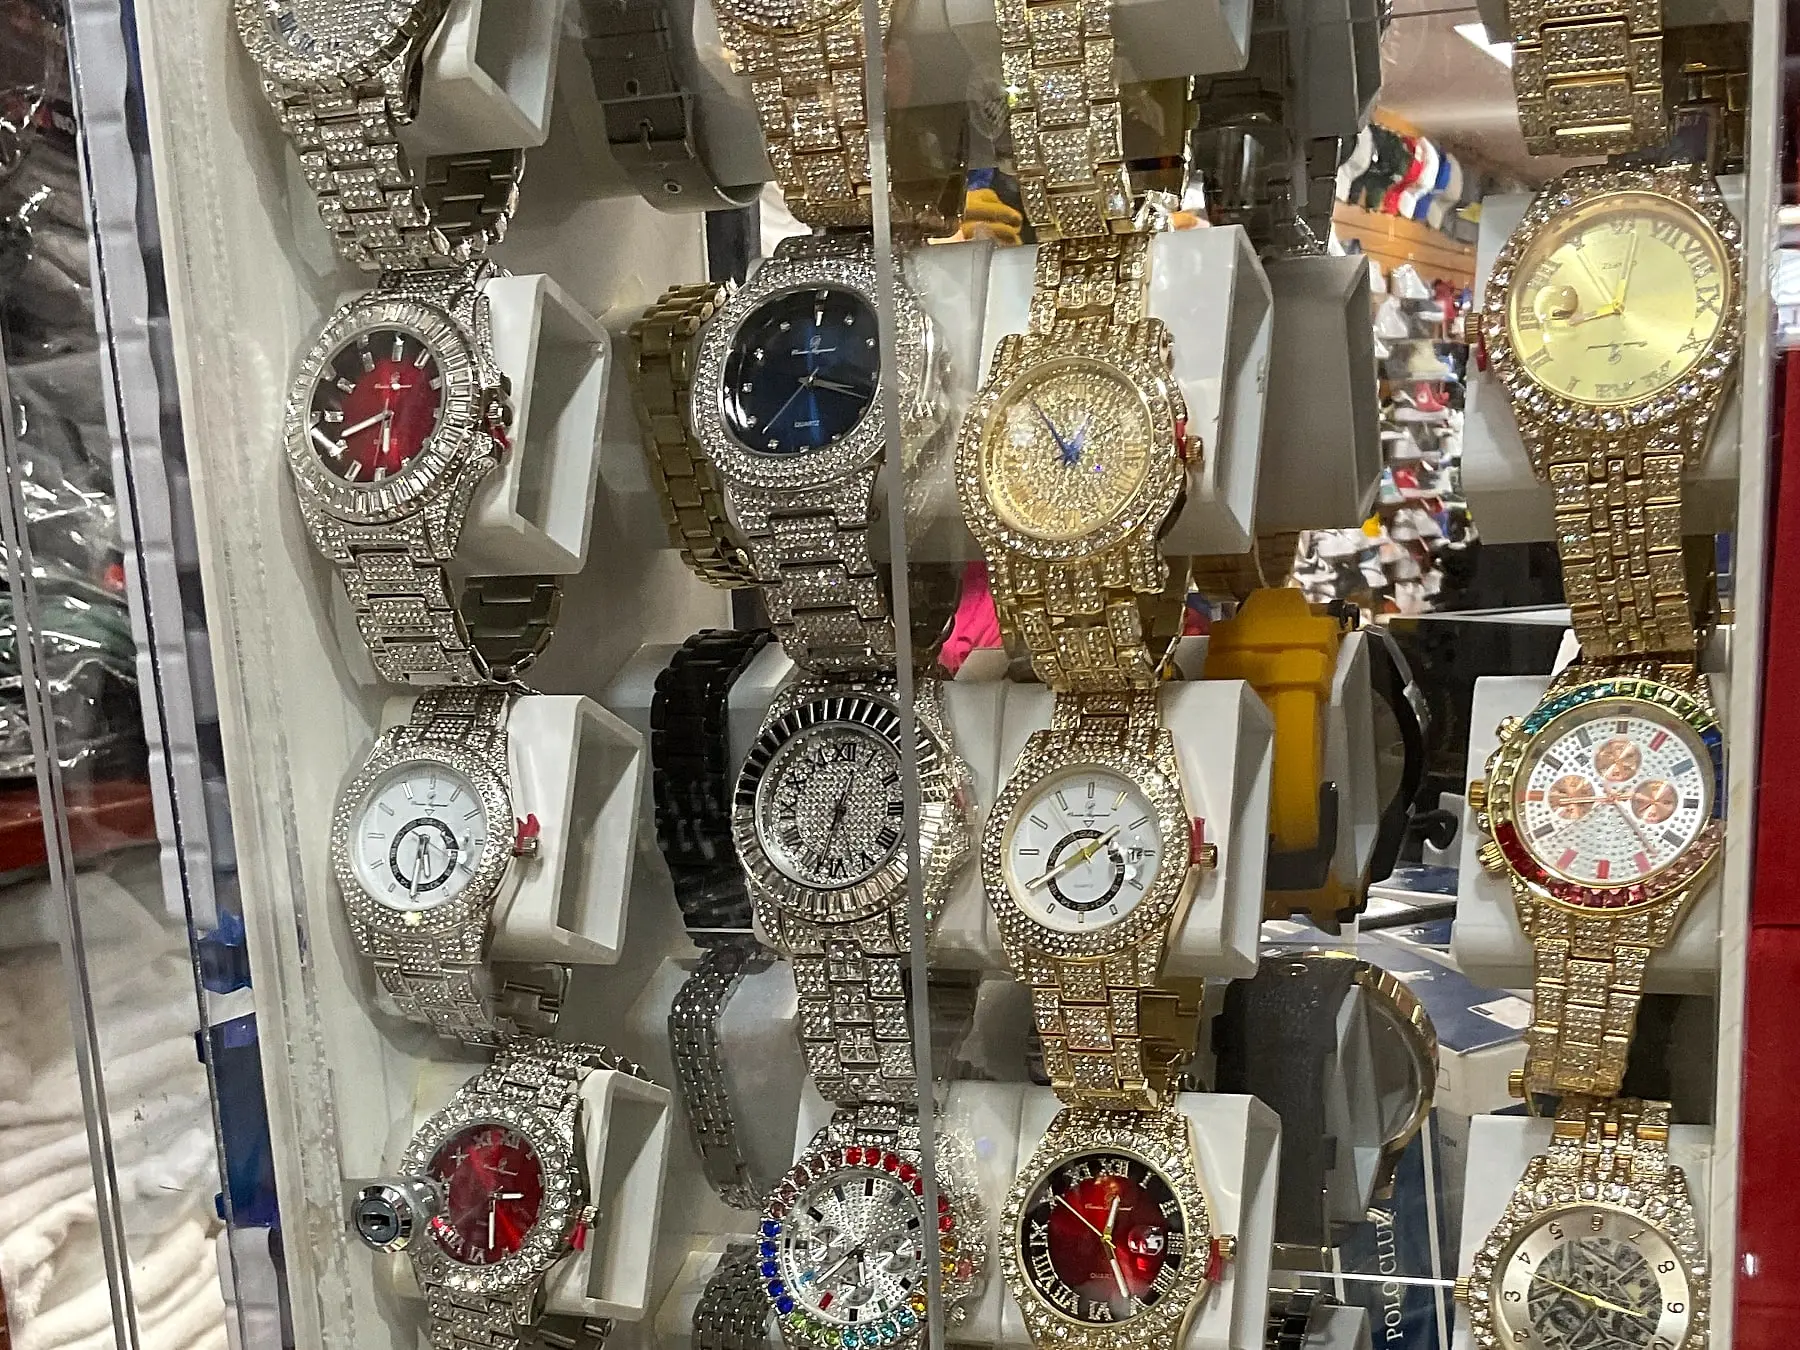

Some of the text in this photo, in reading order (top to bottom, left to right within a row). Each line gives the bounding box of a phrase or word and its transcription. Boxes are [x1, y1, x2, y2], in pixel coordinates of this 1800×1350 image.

[1695, 284, 1721, 318] IX
[1030, 1219, 1049, 1247] IX
[1549, 1220, 1564, 1241] 5
[1516, 1252, 1531, 1265] 4
[1658, 1260, 1675, 1274] 8
[1504, 1291, 1521, 1302] 3
[1382, 1281, 1403, 1342] POLO
[1667, 1302, 1684, 1314] 9
[1513, 1327, 1531, 1342] 2
